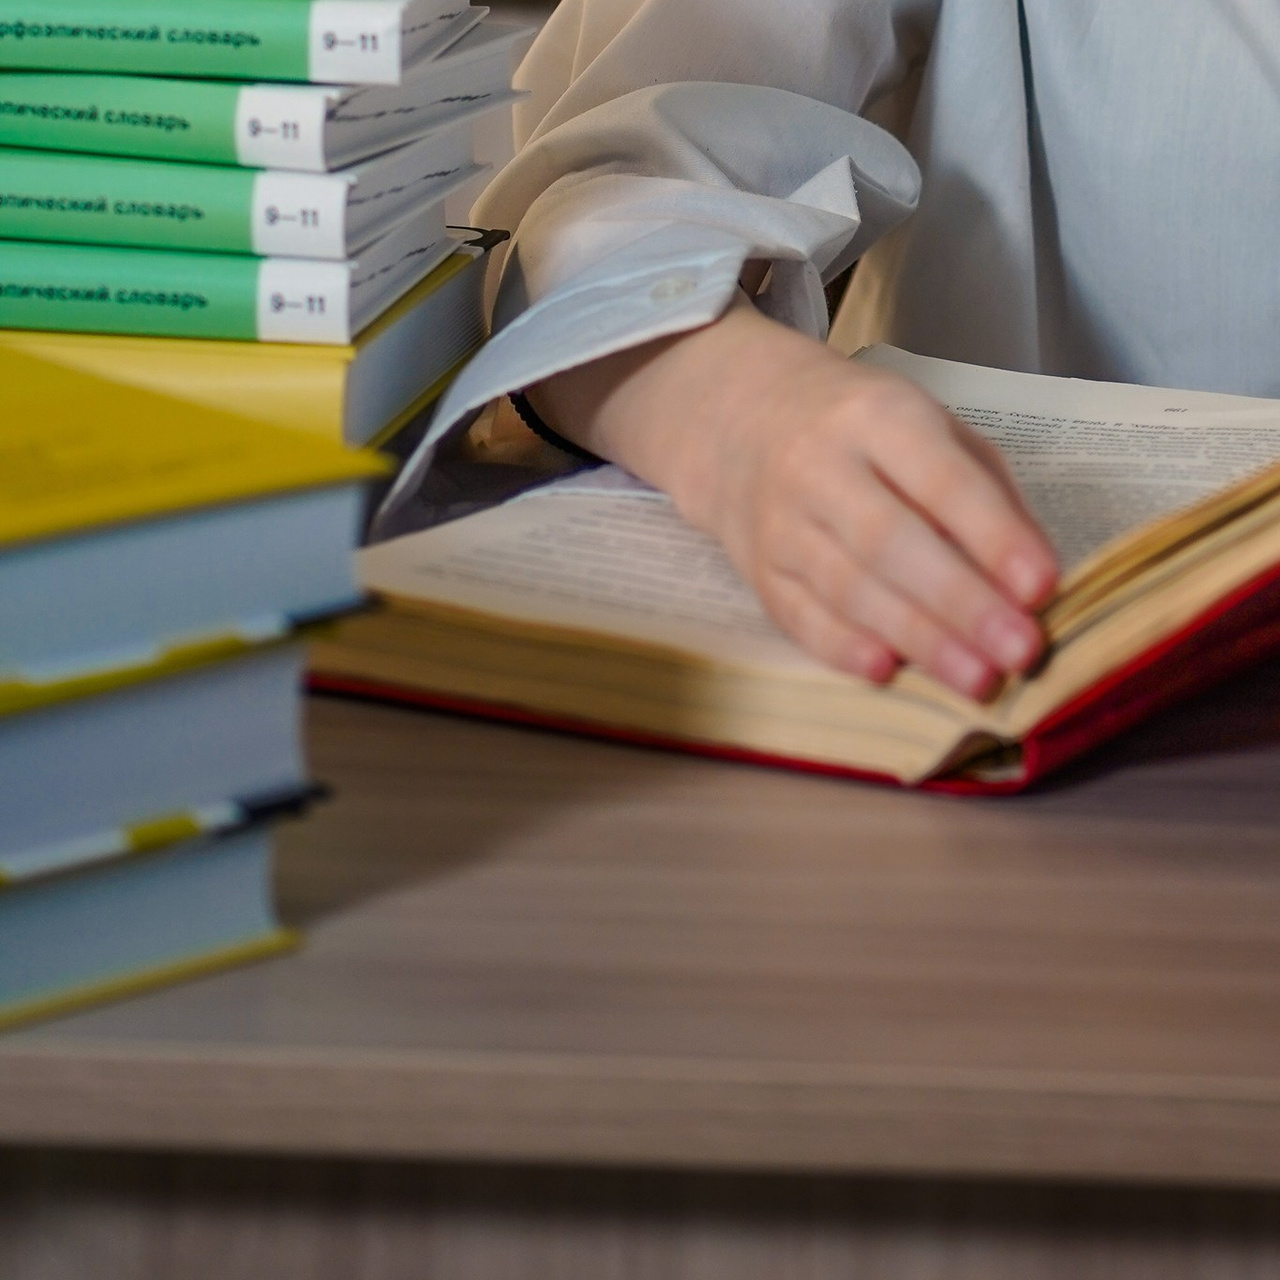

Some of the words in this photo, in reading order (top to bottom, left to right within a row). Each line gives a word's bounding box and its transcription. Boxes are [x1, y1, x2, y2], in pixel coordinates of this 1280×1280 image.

[166, 28, 261, 49] словарь
[103, 109, 190, 132] словарь
[113, 199, 205, 222] словарь
[115, 290, 209, 312] словарь
